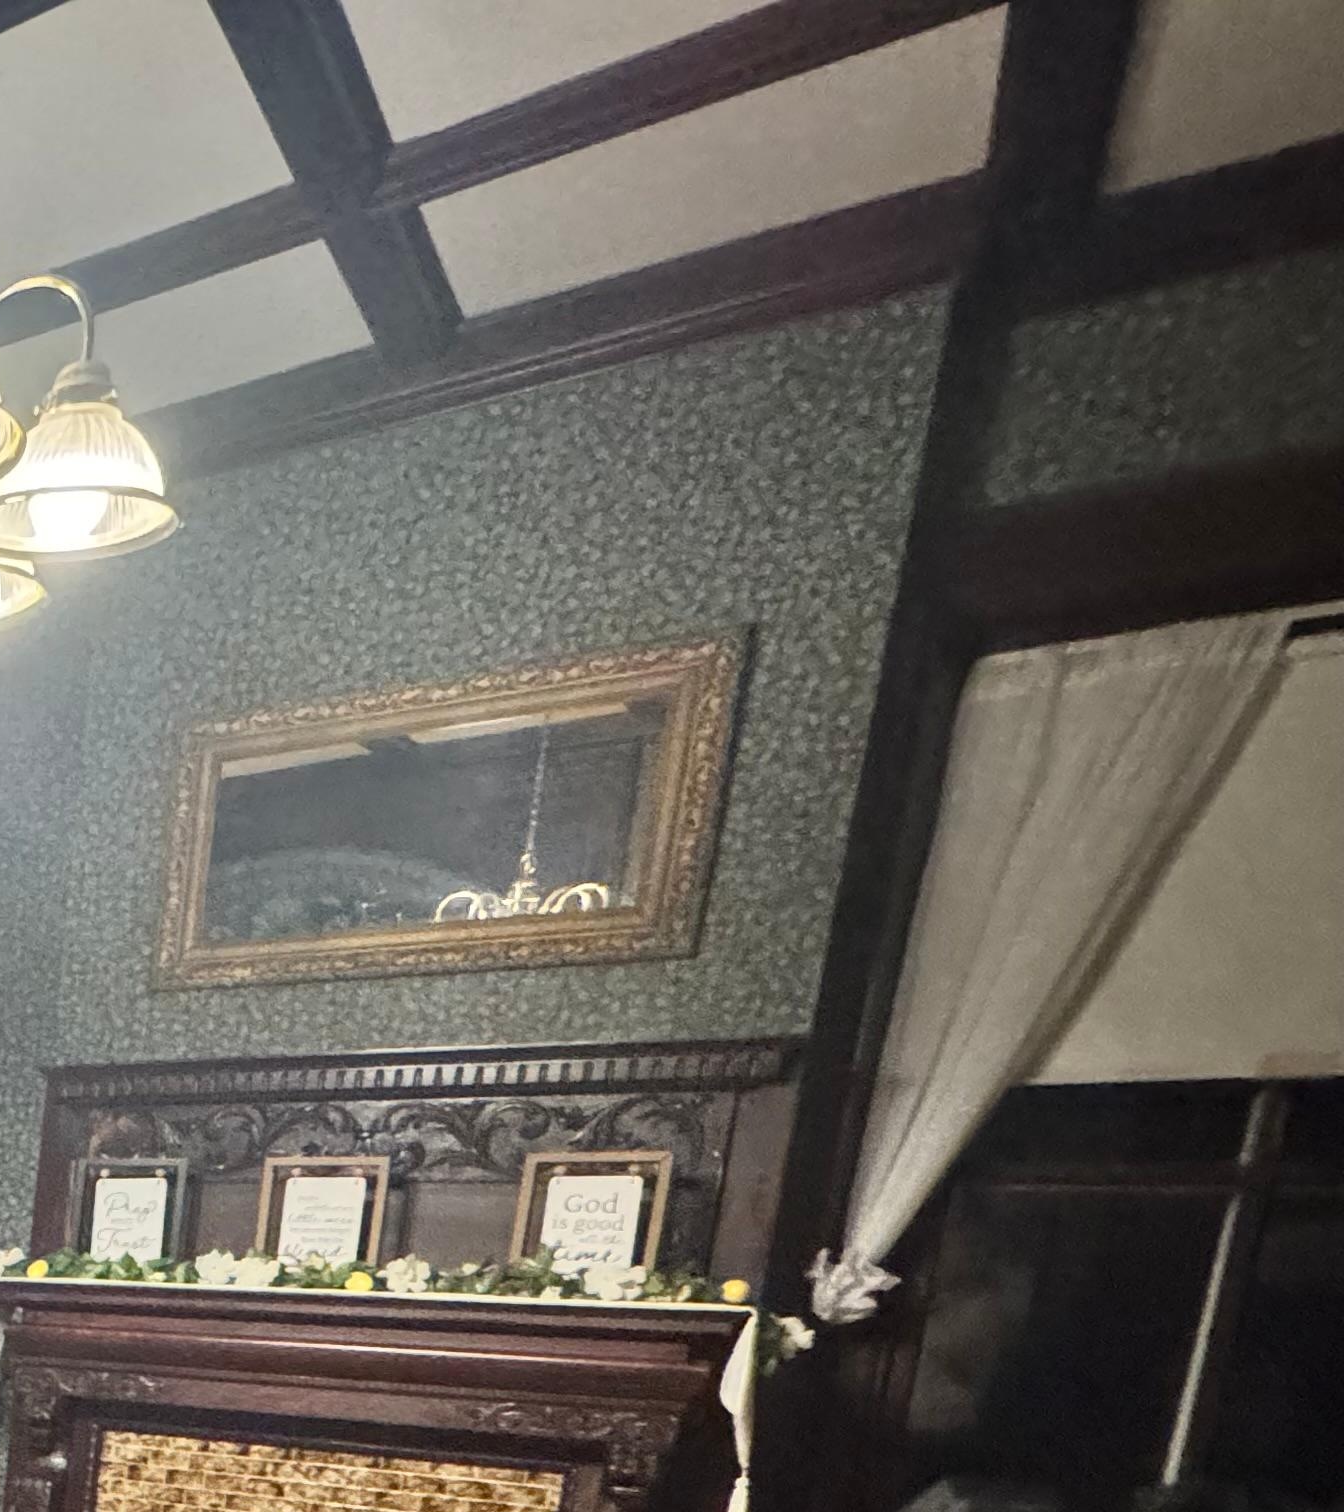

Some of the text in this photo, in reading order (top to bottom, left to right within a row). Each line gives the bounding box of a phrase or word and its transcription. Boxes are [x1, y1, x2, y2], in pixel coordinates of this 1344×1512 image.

[564, 1192, 619, 1214] God
[551, 1214, 625, 1235] is good
